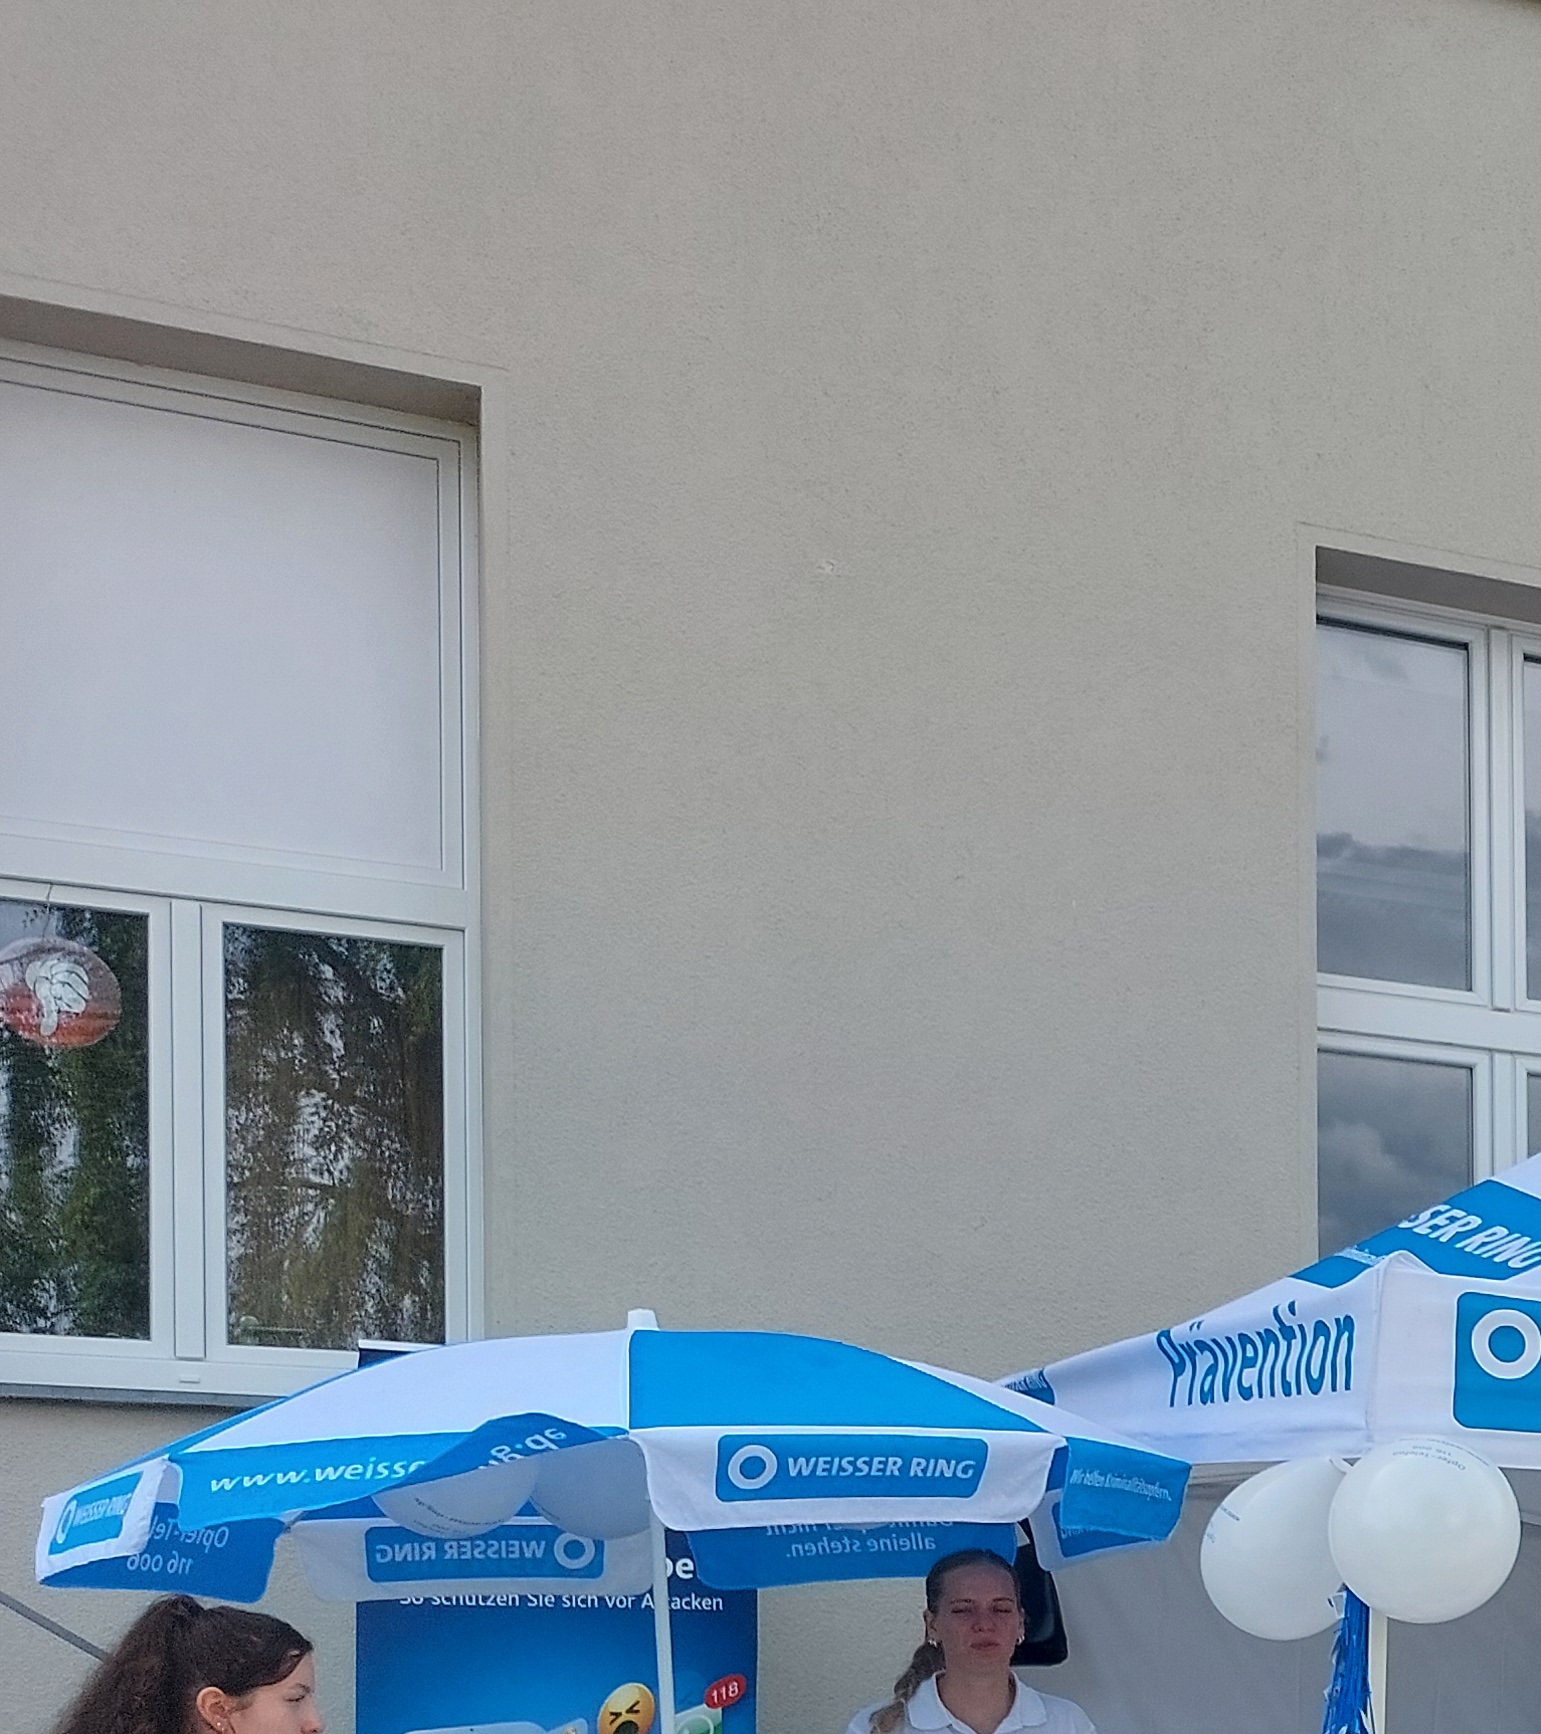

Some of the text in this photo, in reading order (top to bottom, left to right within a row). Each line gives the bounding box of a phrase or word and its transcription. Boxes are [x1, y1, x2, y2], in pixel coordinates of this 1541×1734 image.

[1157, 1300, 1355, 1408] Prävention
[787, 1456, 977, 1480] WEISSER RING
[562, 1592, 600, 1609] sich
[605, 1596, 632, 1609] vor
[640, 1592, 724, 1612] Aacken
[711, 1681, 739, 1704] 118
